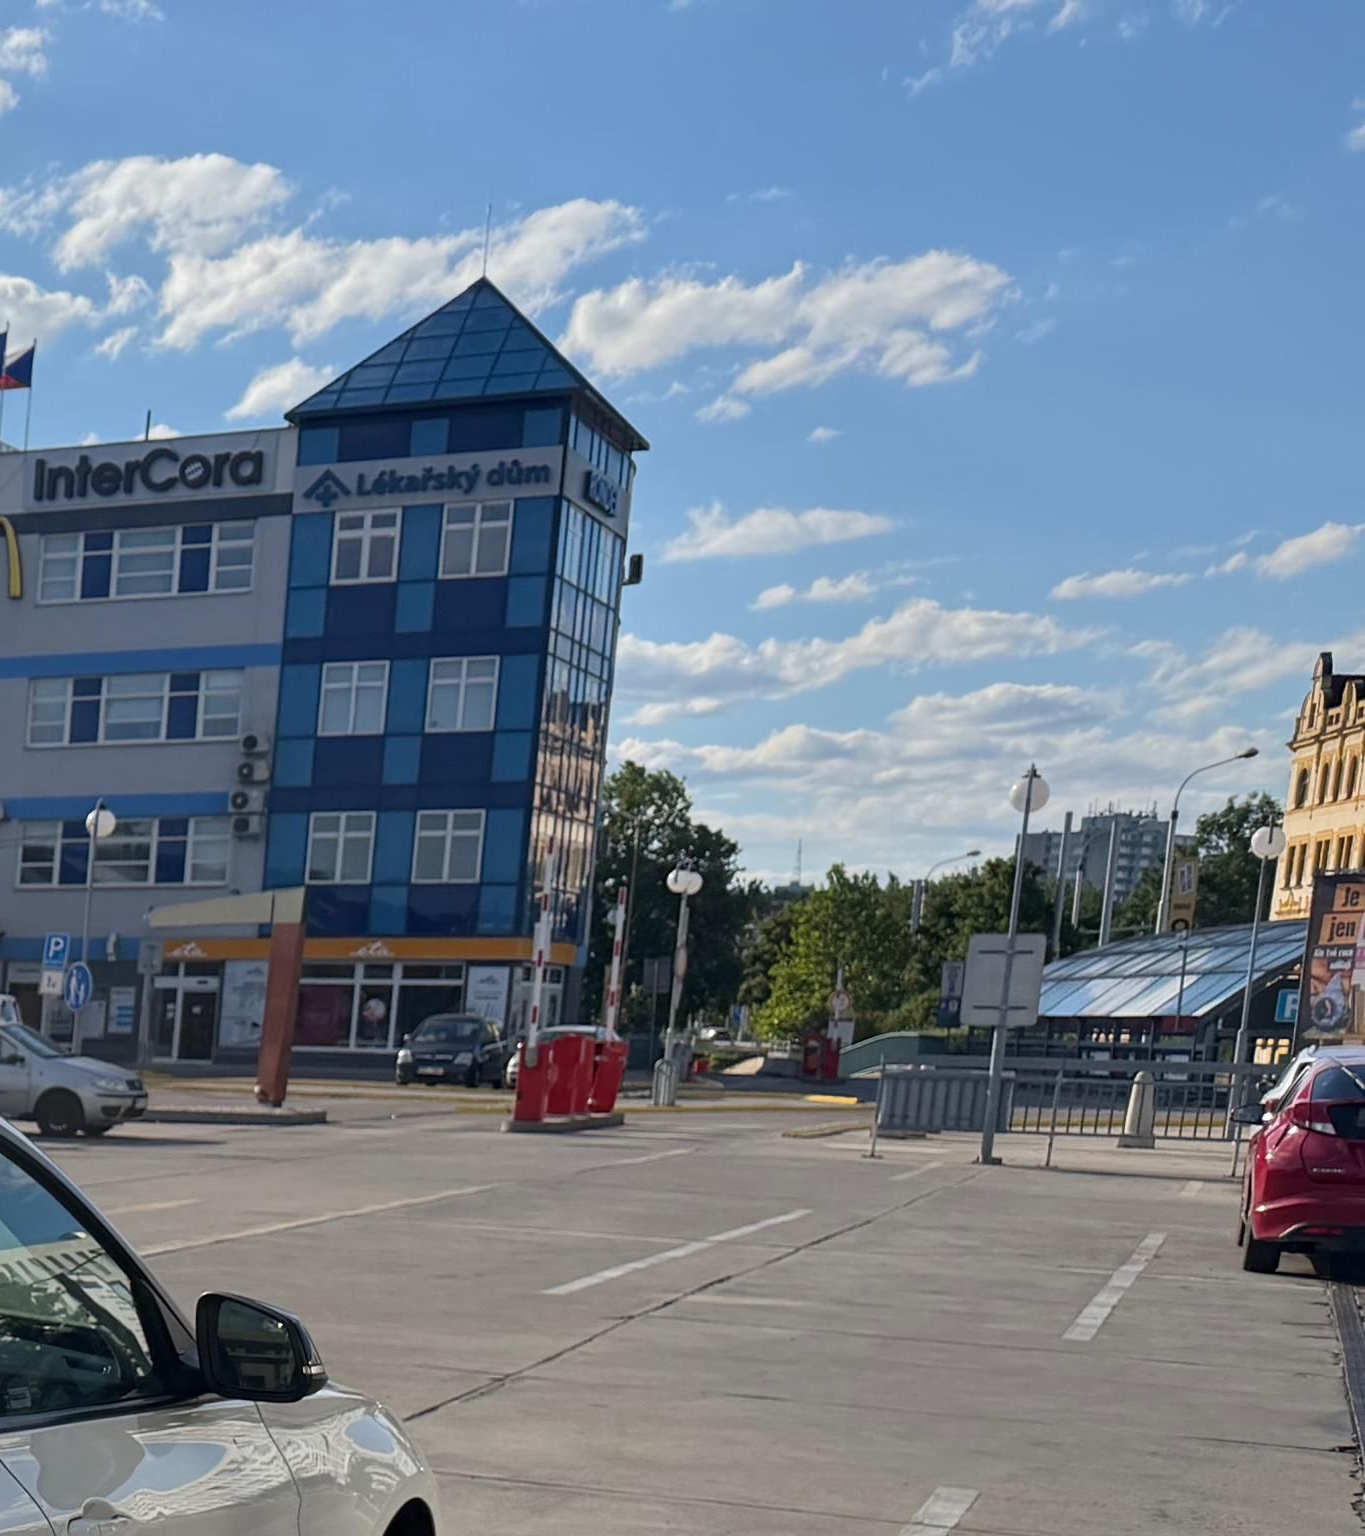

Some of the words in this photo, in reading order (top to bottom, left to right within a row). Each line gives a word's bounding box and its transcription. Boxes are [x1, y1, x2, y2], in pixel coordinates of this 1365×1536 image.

[34, 448, 264, 502] InterCora
[356, 464, 480, 496] Lékařský
[486, 459, 550, 487] dům
[1327, 916, 1356, 942] jen
[48, 937, 65, 958] P
